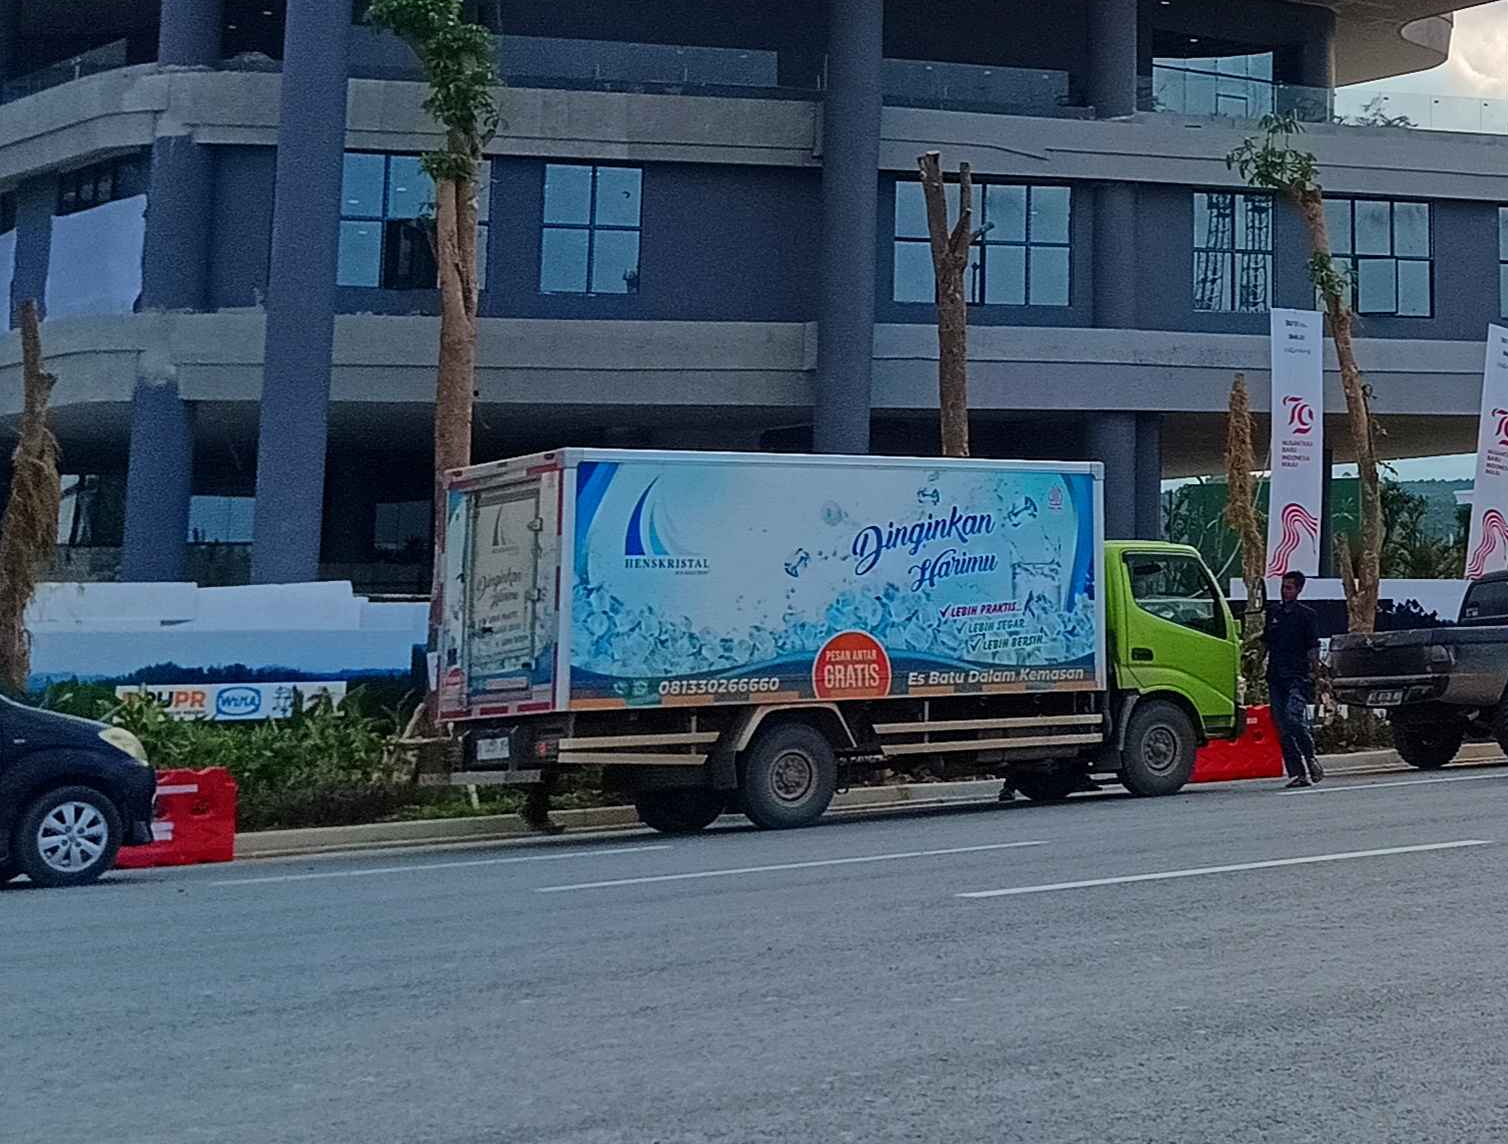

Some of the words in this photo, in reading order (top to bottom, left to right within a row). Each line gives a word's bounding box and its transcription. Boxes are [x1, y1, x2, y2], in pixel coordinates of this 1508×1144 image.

[852, 506, 996, 575] Dinginkan
[625, 558, 710, 568] HENSKRISTAL
[908, 549, 998, 592] Harimu
[951, 605, 978, 617] LEBIH
[968, 621, 994, 633] LEBIH
[983, 638, 1009, 650] LEBIH
[825, 650, 850, 661] PESAN
[852, 650, 877, 660] ANTAR
[823, 663, 880, 689] GRATIS
[908, 672, 925, 685] Es
[928, 671, 964, 685] Batu
[968, 670, 1015, 683] Dalam
[1019, 668, 1084, 682] Kemasan
